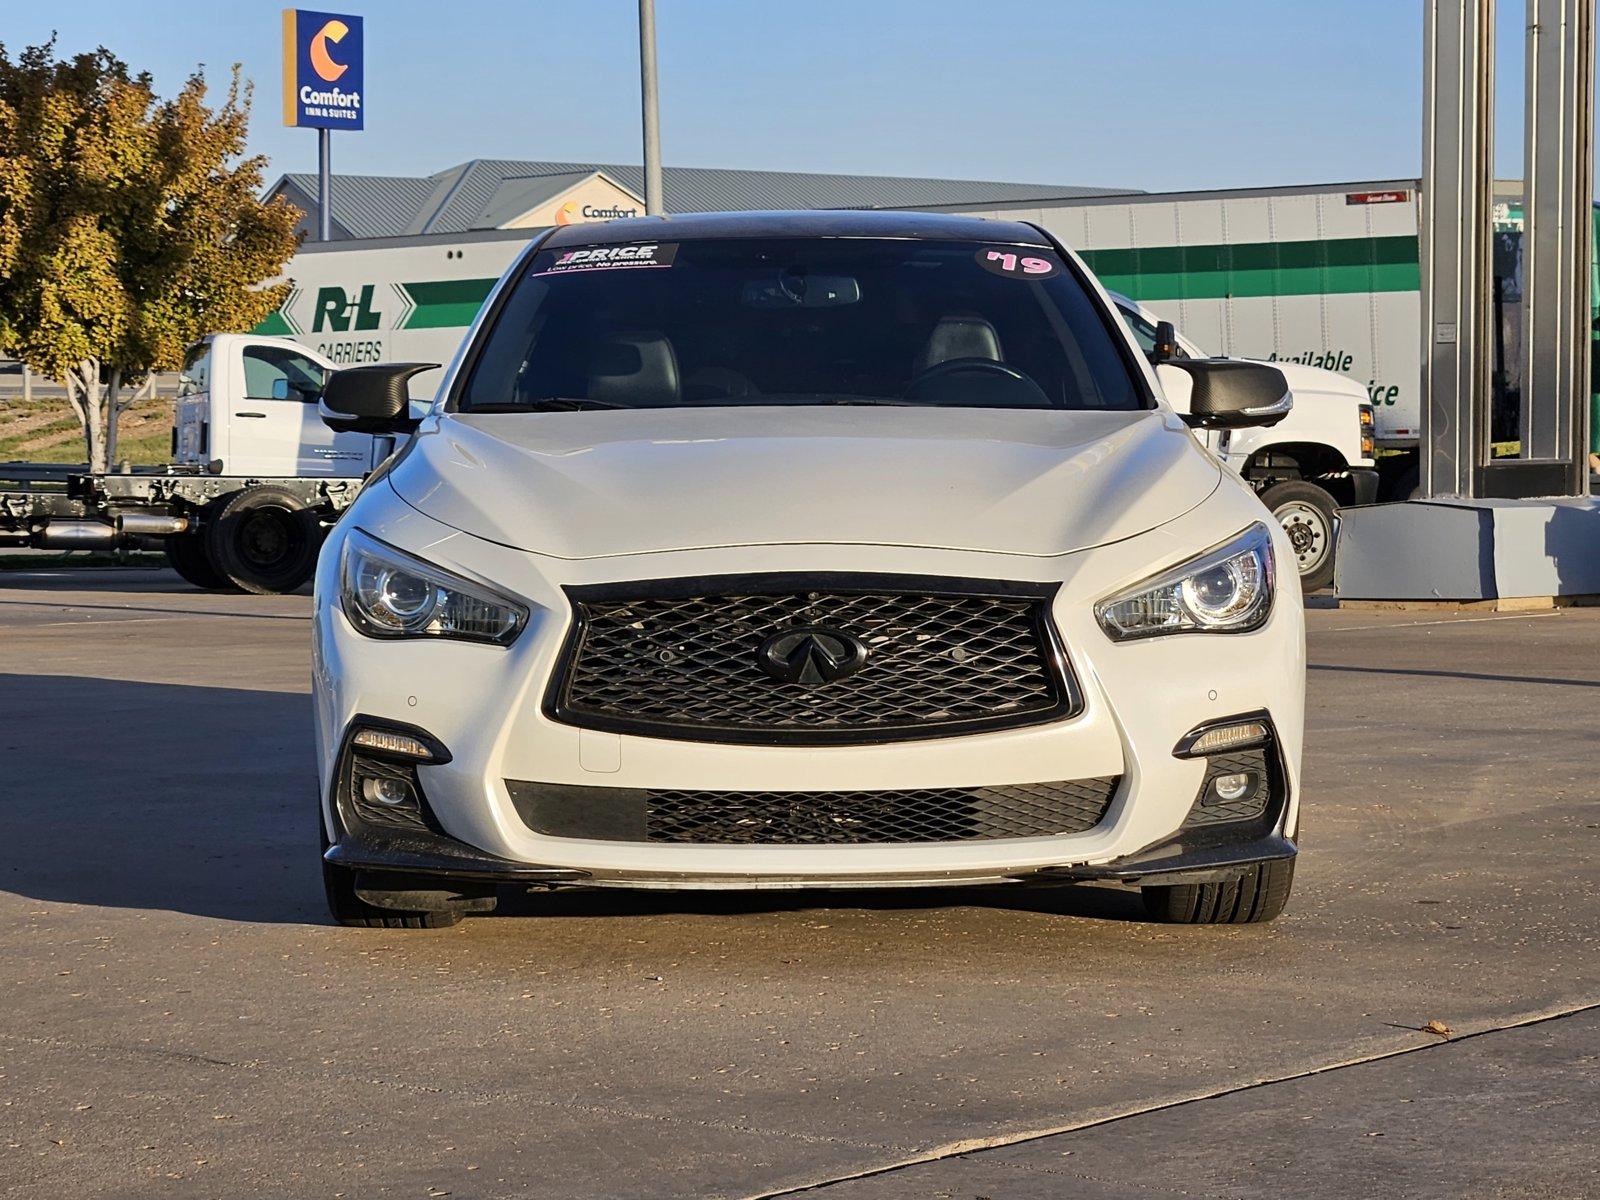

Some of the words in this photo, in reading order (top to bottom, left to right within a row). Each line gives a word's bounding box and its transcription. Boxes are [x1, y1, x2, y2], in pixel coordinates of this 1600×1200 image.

[300, 86, 360, 108] Comfort
[305, 107, 321, 116] INN
[322, 108, 329, 117] &
[328, 109, 357, 119] SUITES
[583, 205, 637, 218] Comfort
